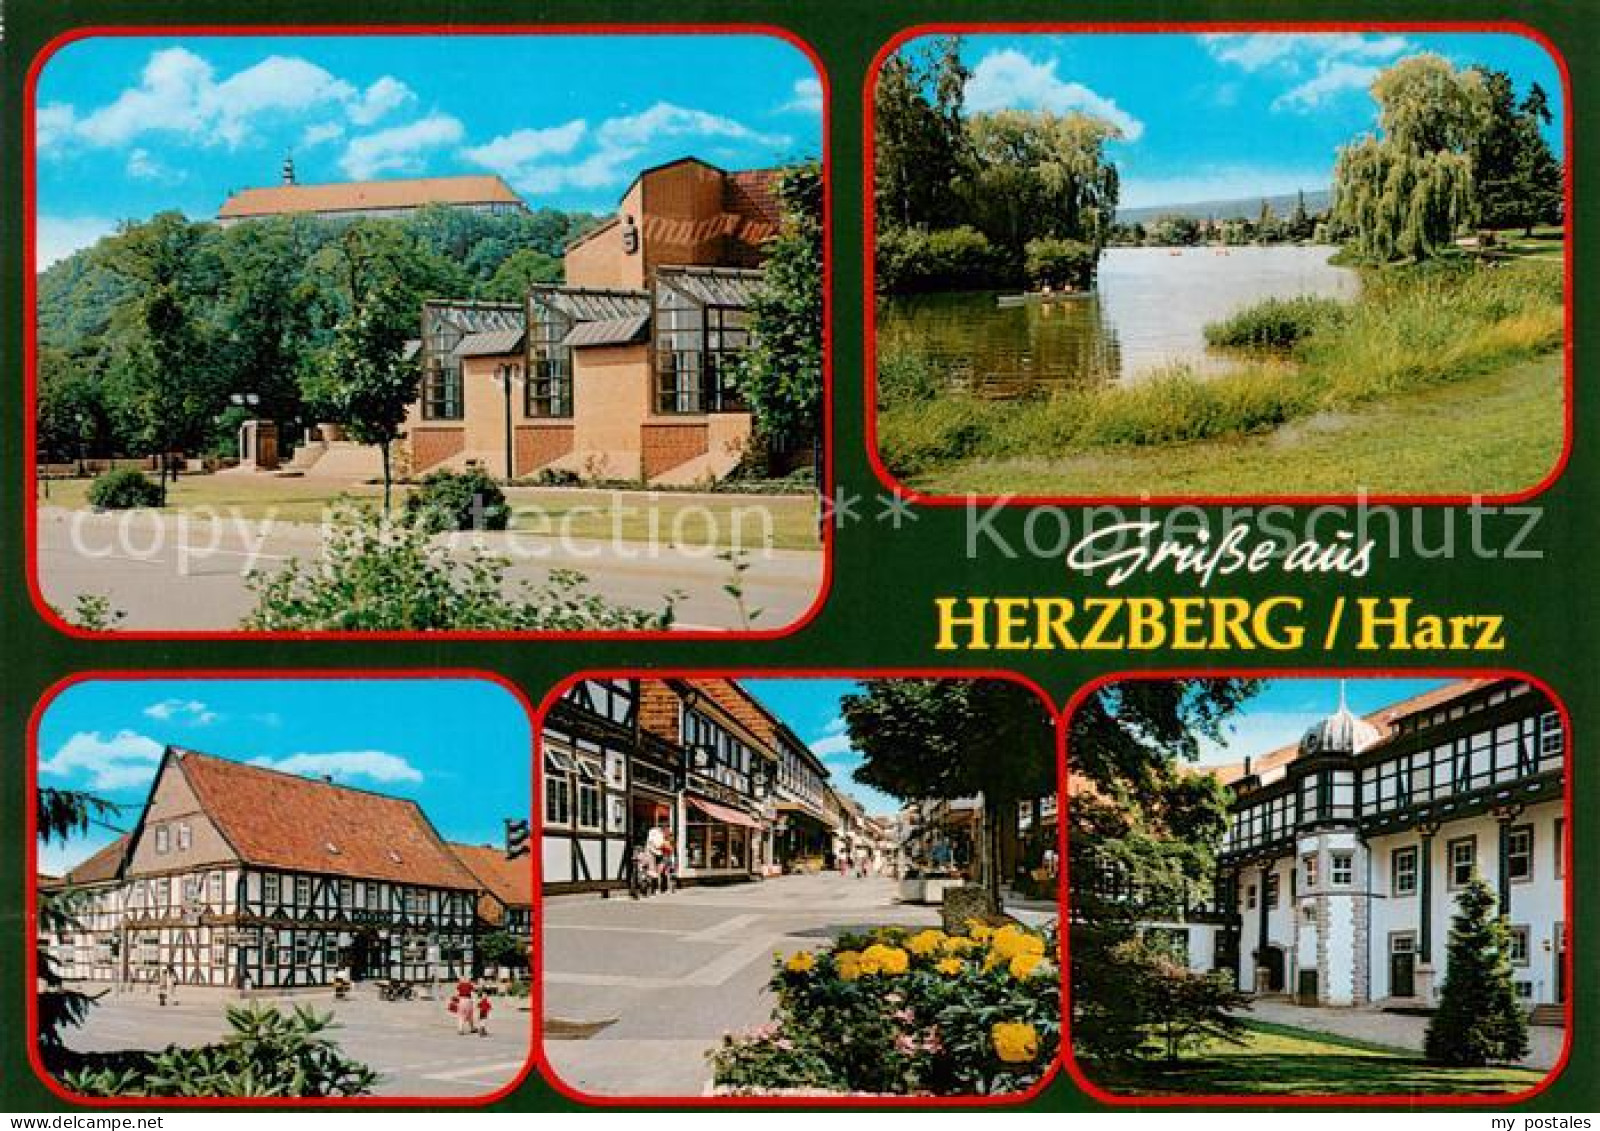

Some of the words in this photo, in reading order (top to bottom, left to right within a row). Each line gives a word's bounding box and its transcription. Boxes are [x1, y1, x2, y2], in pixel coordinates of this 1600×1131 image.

[1281, 532, 1376, 577] aus
[935, 596, 1305, 650] HERZBERG
[1356, 598, 1505, 650] Harz
